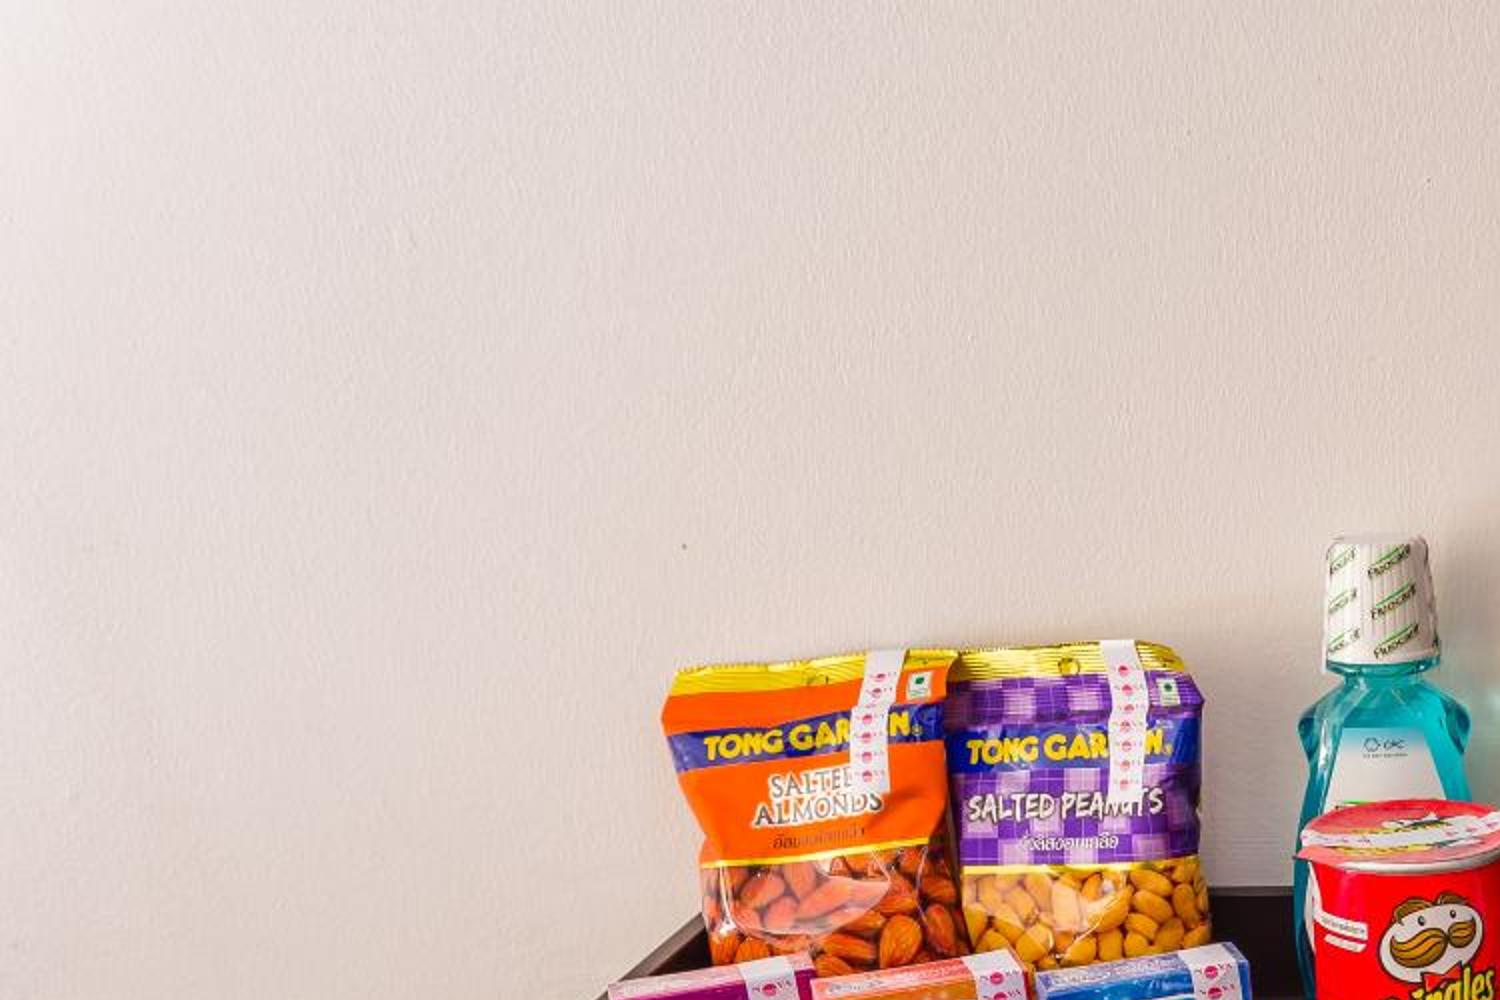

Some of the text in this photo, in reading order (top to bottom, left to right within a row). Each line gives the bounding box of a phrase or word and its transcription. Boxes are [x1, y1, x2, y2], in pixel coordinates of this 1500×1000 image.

[704, 711, 911, 760] TONG GARN
[967, 728, 1163, 766] TONG GARN
[755, 791, 884, 826] ALMONDS
[968, 793, 1056, 823] SALTED
